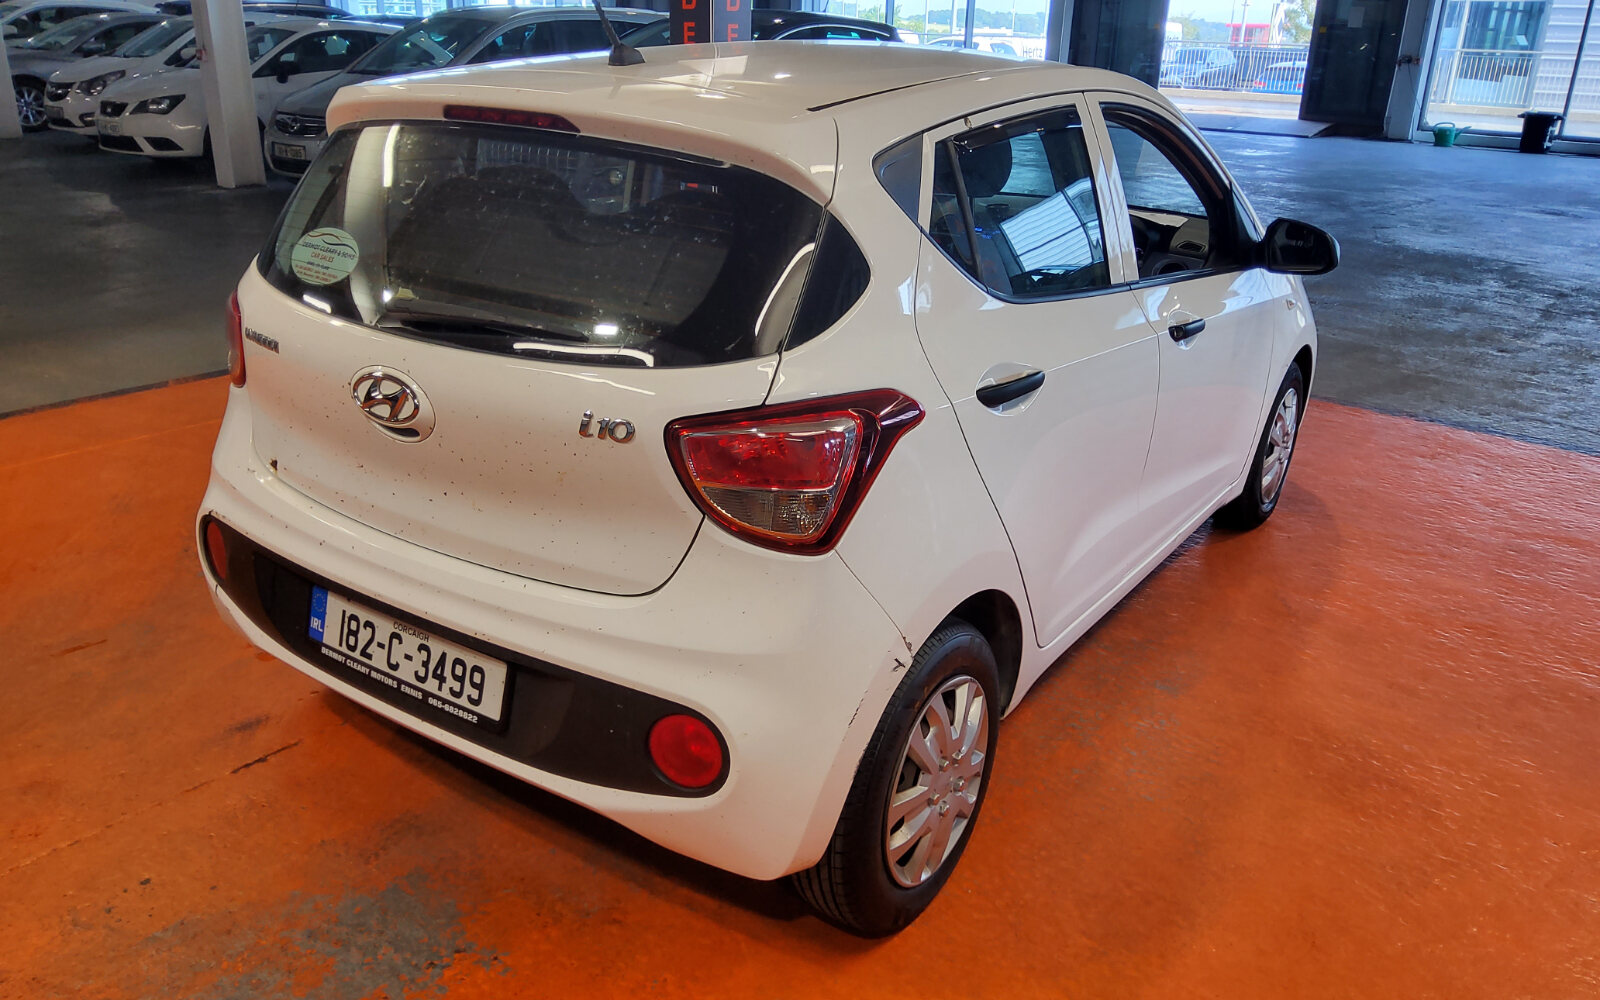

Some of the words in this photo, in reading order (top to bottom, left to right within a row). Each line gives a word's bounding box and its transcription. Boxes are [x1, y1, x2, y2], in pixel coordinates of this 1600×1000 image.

[1022, 46, 1043, 59] Hertz
[310, 616, 324, 633] IRL
[393, 621, 430, 643] CORCAIGH
[339, 609, 486, 707] 182-C-3499
[321, 646, 346, 664] DERMOT
[346, 659, 370, 675] CLEARY
[370, 671, 398, 688] MOTORS
[400, 684, 423, 699] ENNIS
